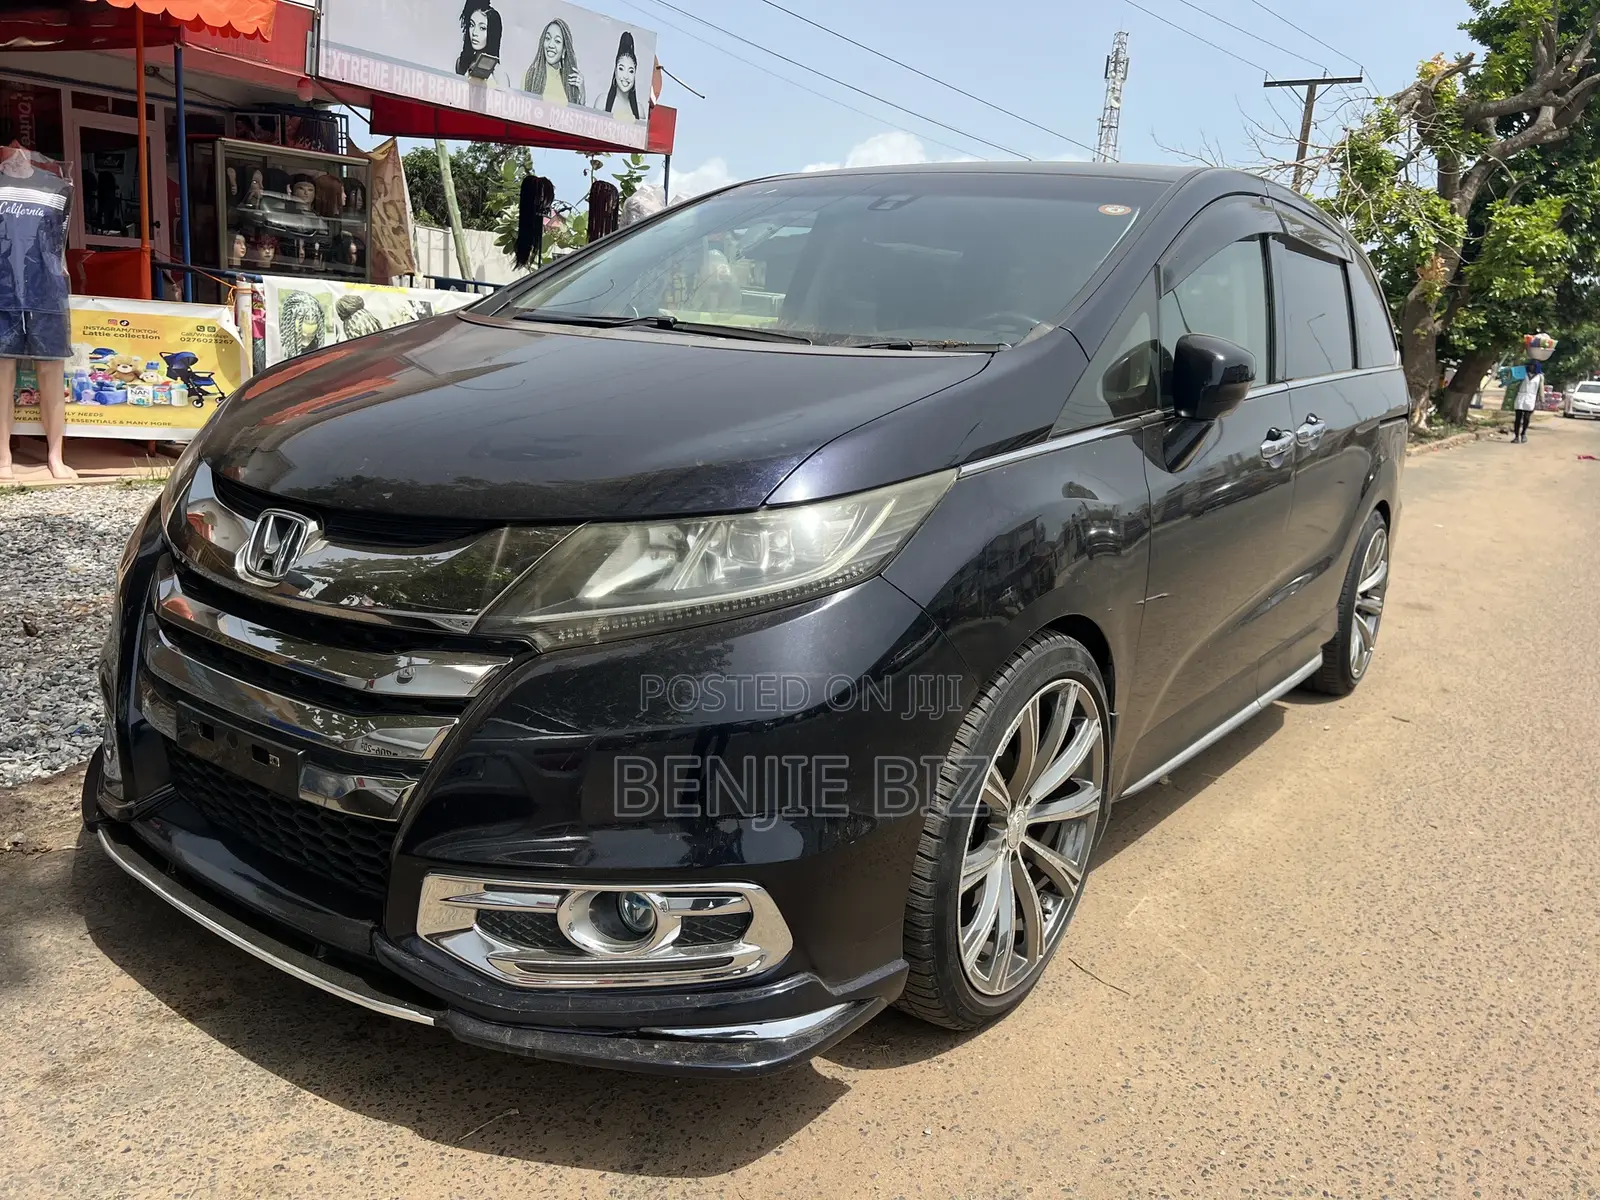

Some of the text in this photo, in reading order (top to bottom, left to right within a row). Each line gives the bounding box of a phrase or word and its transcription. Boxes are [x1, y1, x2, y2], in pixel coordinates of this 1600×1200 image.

[393, 66, 424, 97] HAIR
[429, 75, 476, 109] BEAUTY
[0, 201, 44, 218] California
[83, 325, 159, 335] INSTAGRAM/TIKTOK
[181, 331, 228, 339] Call/WhatsApp
[113, 332, 161, 340] collection
